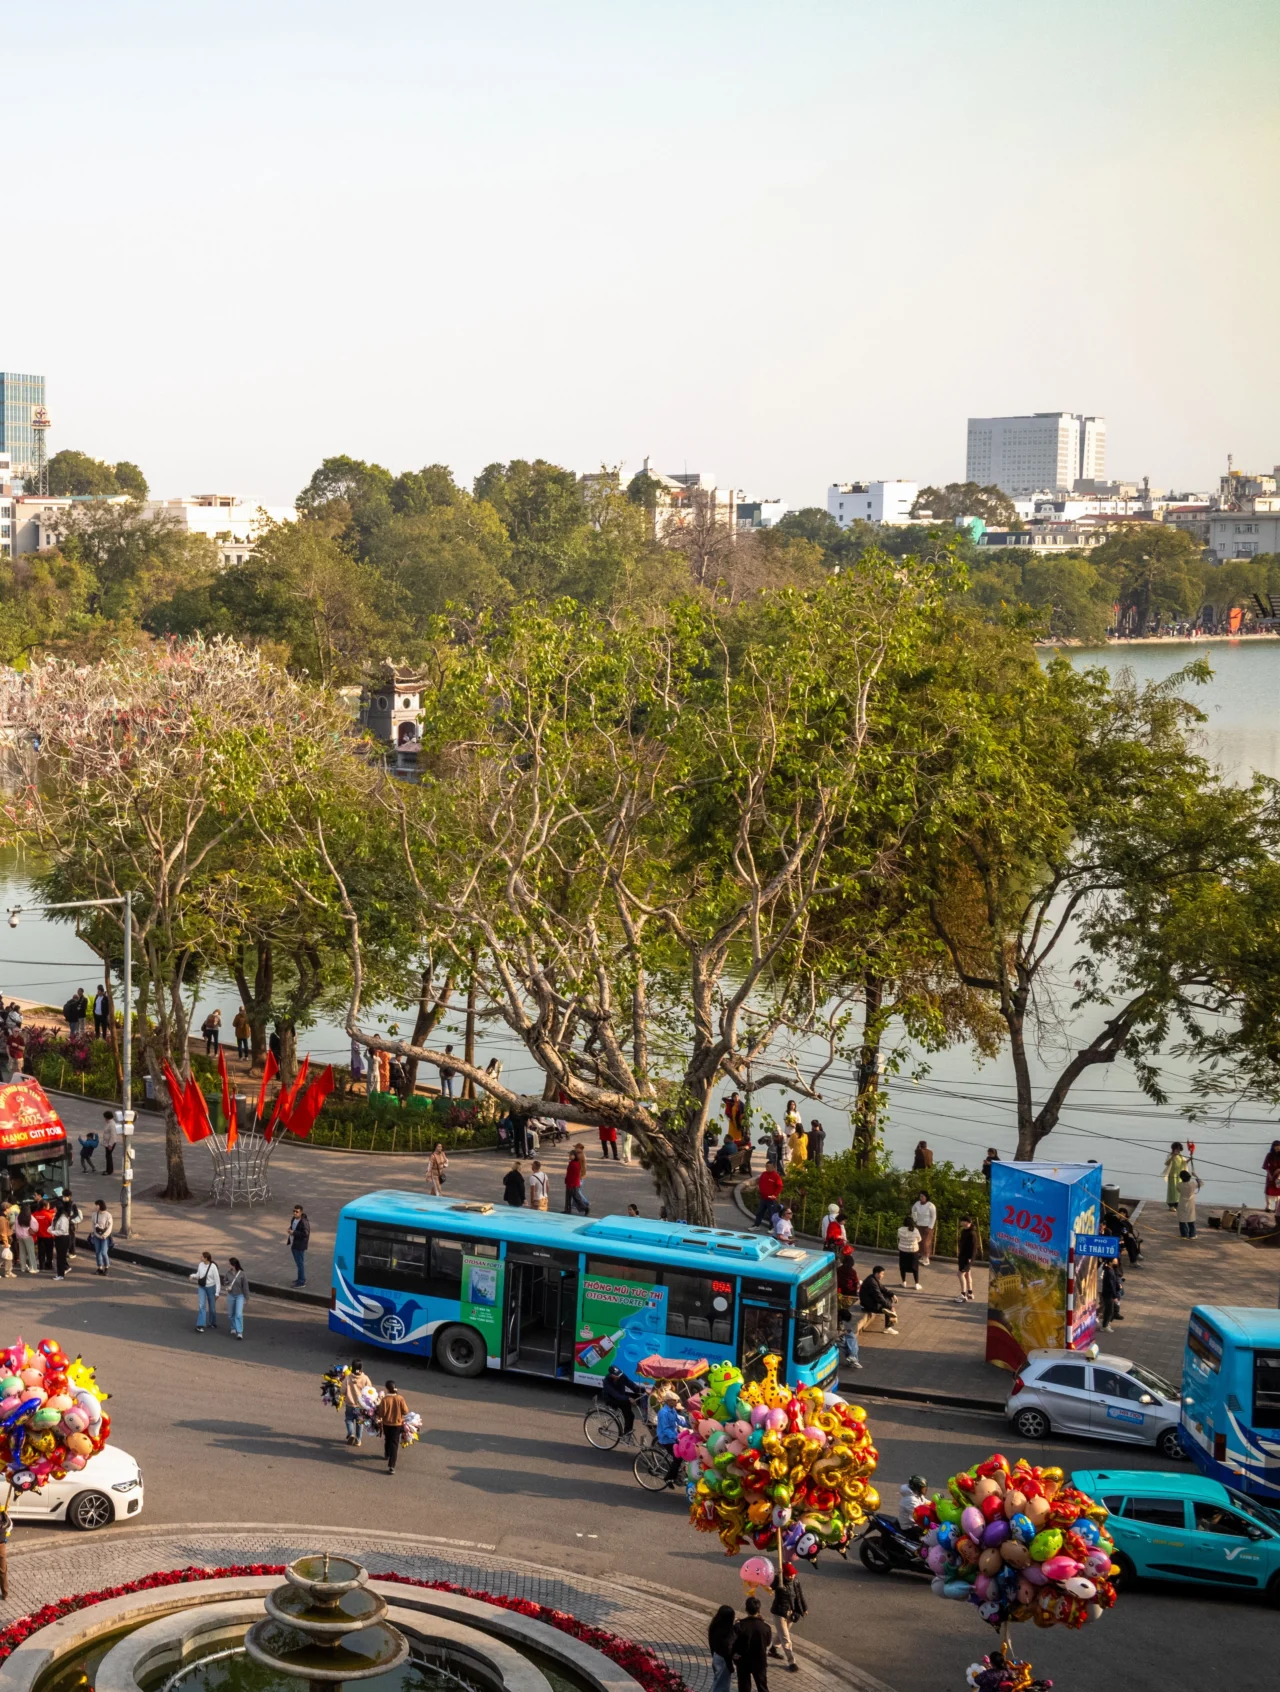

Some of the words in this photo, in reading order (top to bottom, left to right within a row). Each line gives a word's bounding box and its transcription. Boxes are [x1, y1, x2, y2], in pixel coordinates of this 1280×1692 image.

[2, 1132, 28, 1144] HANOI
[29, 1129, 46, 1139] CITY
[46, 1126, 62, 1136] TOUR
[1002, 1205, 1056, 1243] 2025
[1089, 1245, 1104, 1253] THÁI
[464, 1258, 486, 1267] OTOSAN
[487, 1261, 503, 1269] FORTE
[583, 1280, 612, 1292] THÔNG
[613, 1284, 630, 1295] MŨI
[631, 1286, 648, 1298] TỨC
[586, 1291, 618, 1302] OTOSAN
[619, 1296, 643, 1307] FORTE
